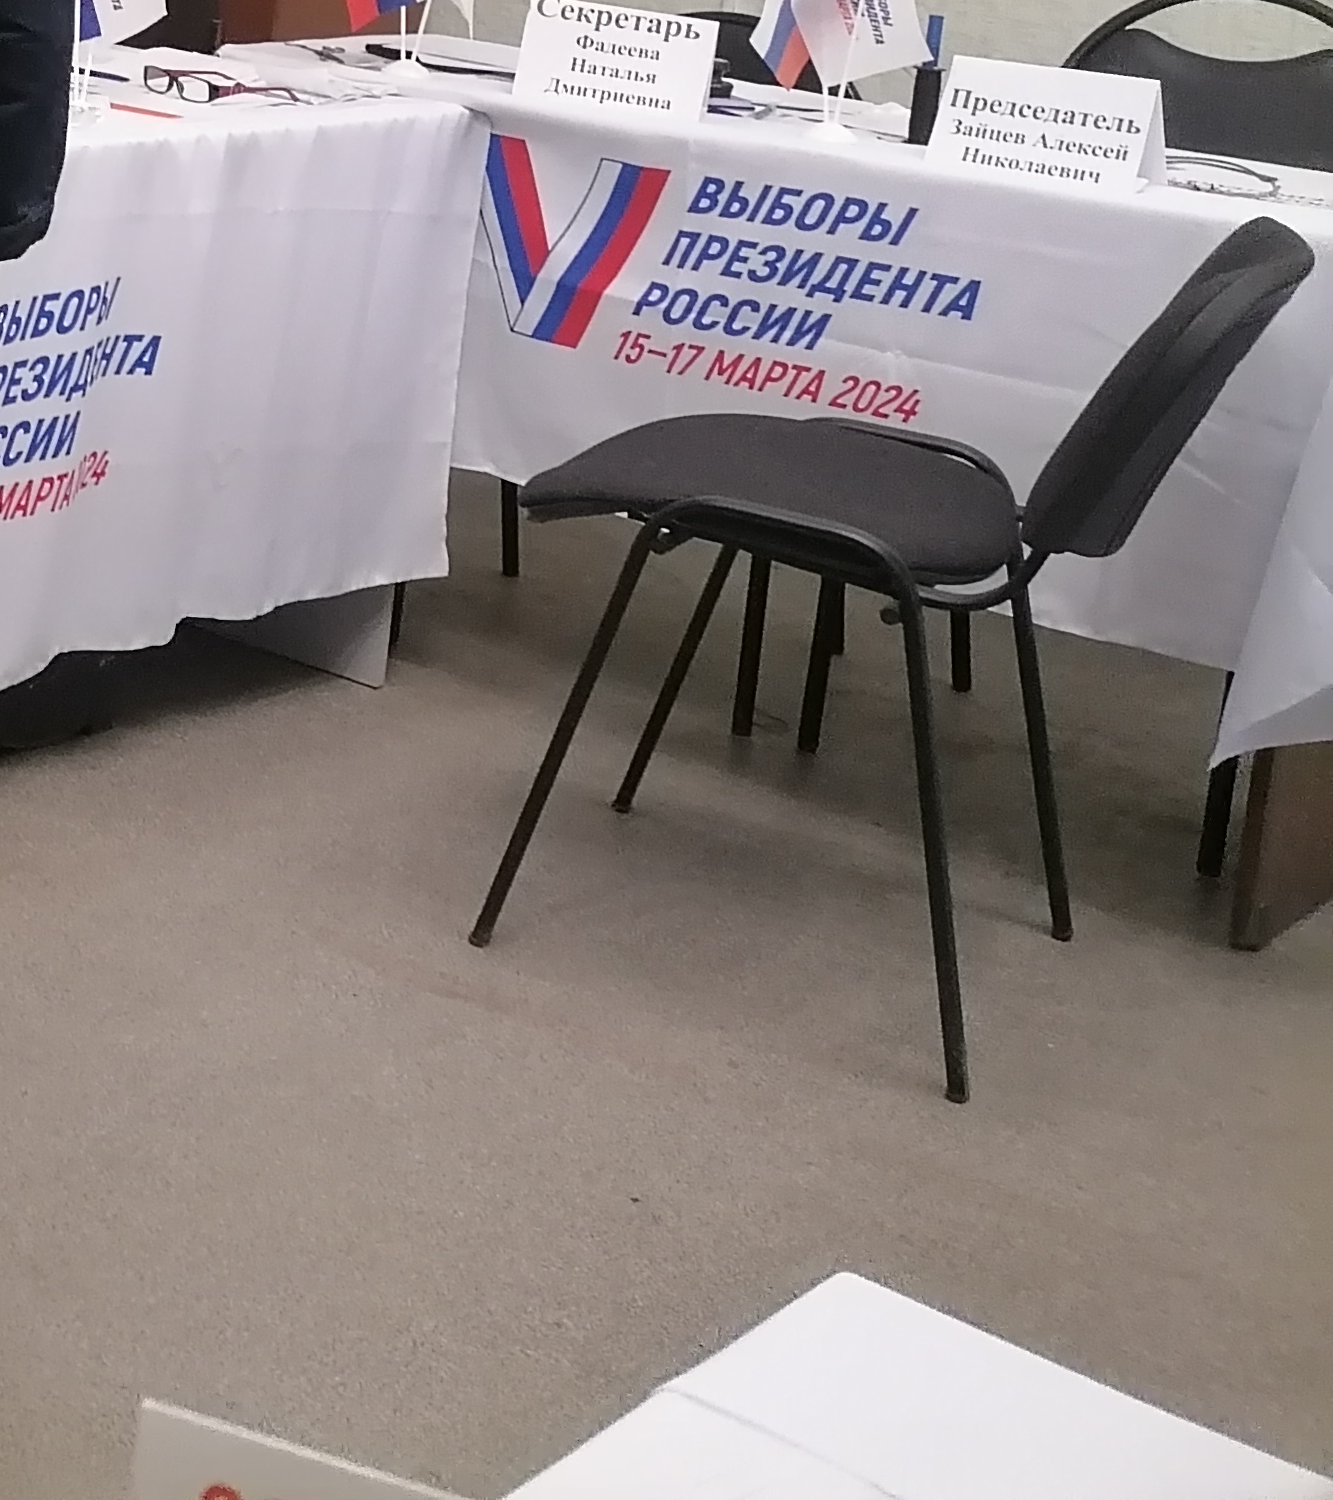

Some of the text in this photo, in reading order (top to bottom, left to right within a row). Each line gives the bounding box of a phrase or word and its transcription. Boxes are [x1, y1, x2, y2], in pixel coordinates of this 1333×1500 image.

[570, 57, 657, 84] Наталья
[576, 34, 660, 61] Фадеева
[544, 77, 671, 110] Дмитриевна
[950, 87, 1142, 135] Председатель
[949, 118, 1129, 162] Зайцев Алексей
[961, 146, 1101, 184] Николаевич
[687, 175, 919, 246] ВЫБОРЫ
[662, 230, 982, 321] ПРЕЗИДЕНТА
[632, 281, 832, 351] РОССИИ
[704, 349, 826, 404] МАРТА
[828, 375, 921, 424] 2024
